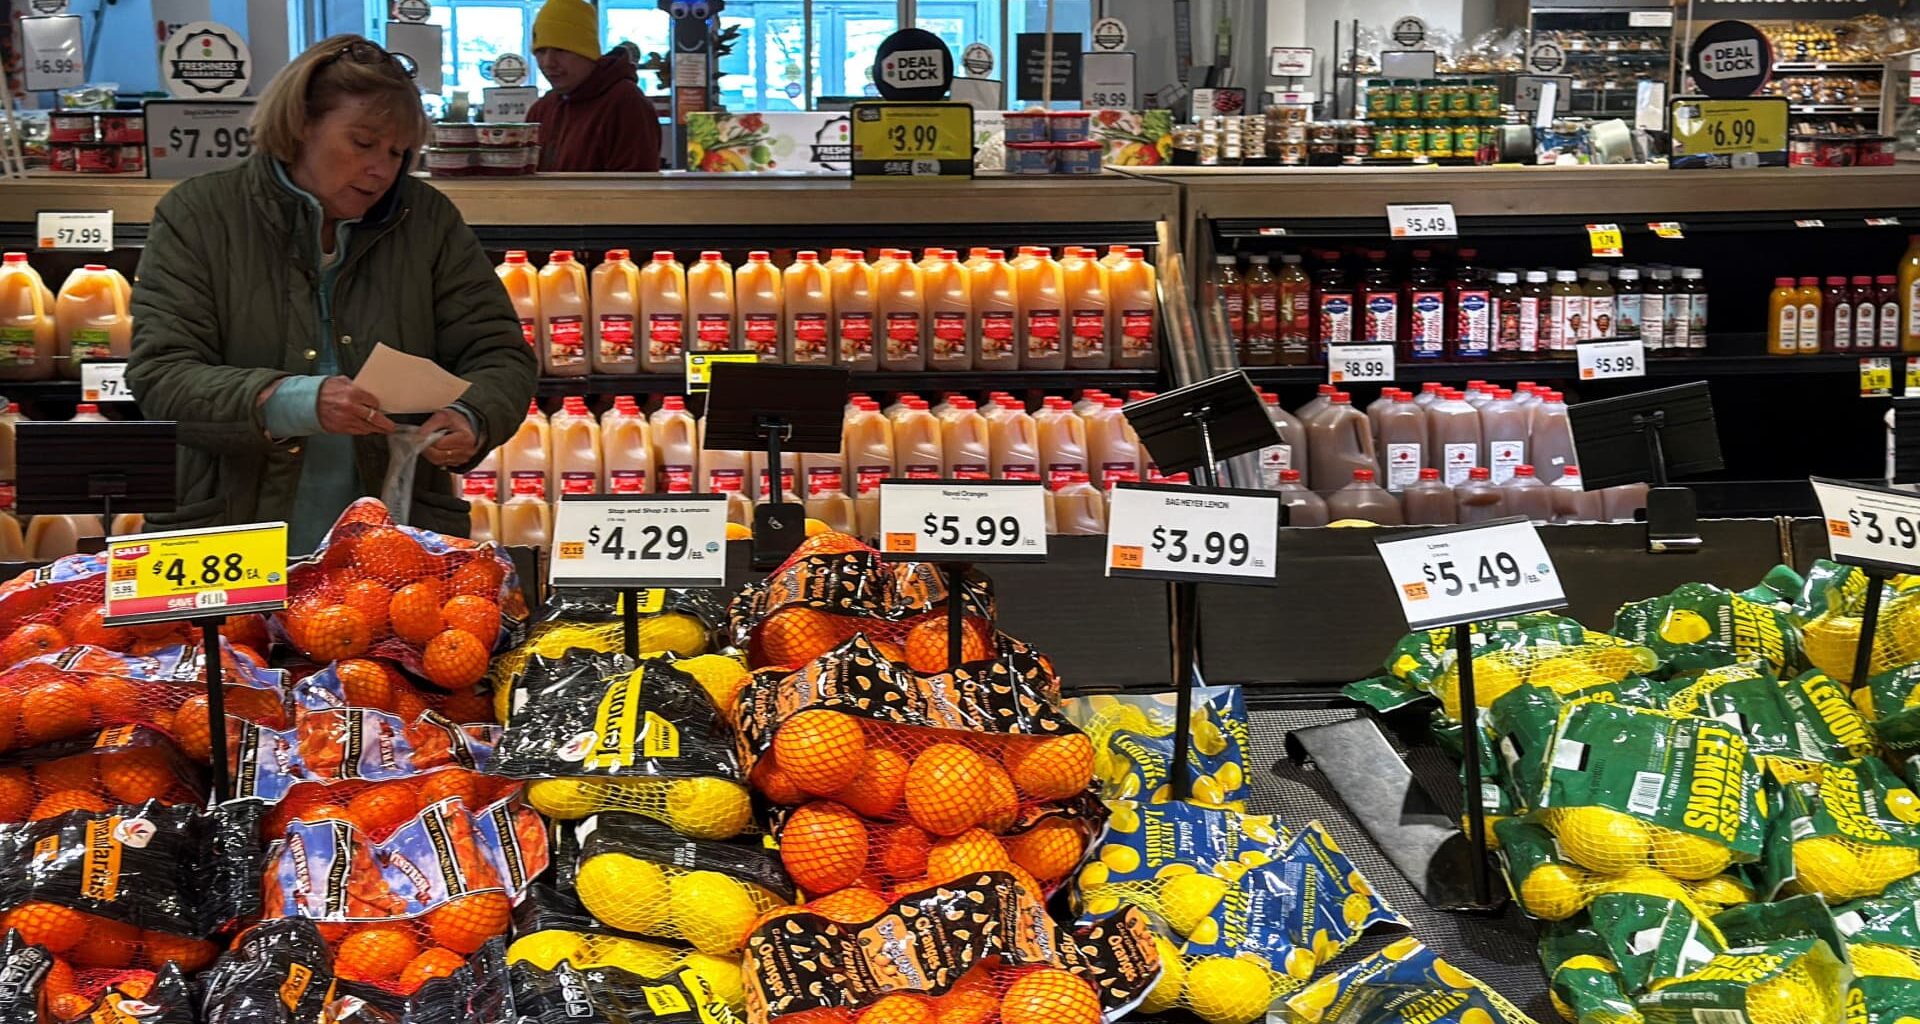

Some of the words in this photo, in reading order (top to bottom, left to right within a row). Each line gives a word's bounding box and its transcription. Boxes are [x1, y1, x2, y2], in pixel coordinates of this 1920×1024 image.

[178, 62, 237, 71] FRESHNESS
[898, 56, 933, 69] DEAL
[1715, 46, 1753, 60] DEAL
[1716, 59, 1755, 72] LOCK
[899, 68, 938, 81] LOCK
[169, 126, 251, 159] $7.99
[888, 125, 937, 152] $3.99
[1708, 119, 1755, 146] $6.99
[884, 162, 911, 173] SAVE
[1705, 157, 1729, 168] SAVE
[57, 227, 101, 244] $7.99
[1407, 217, 1445, 232] $5.49
[1345, 361, 1383, 377] $8.99
[1596, 356, 1634, 373] $5.99
[961, 490, 988, 499] Oranges
[1181, 499, 1203, 507] MEYER
[1204, 501, 1229, 509] LEMON
[588, 525, 688, 561] $4.29
[923, 512, 1020, 547] $5.99
[1848, 508, 1920, 550] $3.9
[114, 545, 149, 557] SALE
[1151, 525, 1249, 567] $3.99
[1427, 543, 1448, 551] Limes
[152, 553, 243, 587] $4.88
[1422, 552, 1521, 597] $5.49
[167, 597, 194, 608] SAVE
[1801, 675, 1873, 757] LEMONS
[351, 711, 362, 757] MANDARINS
[1113, 733, 1157, 790] Lemons
[1682, 726, 1730, 833] LEMONS
[1719, 734, 1747, 843] SEEDLESS
[1145, 810, 1165, 869] Lemons
[1162, 822, 1176, 859] MEYER
[328, 865, 342, 912] MANDARIN
[390, 850, 431, 896] VINEFRESH
[915, 917, 939, 970] Oranges
[1060, 932, 1077, 964] nges
[1107, 935, 1136, 982] Oranges
[758, 943, 787, 996] Oranges
[772, 928, 794, 971] CALIFORNIA
[787, 972, 803, 998] SWEET
[839, 939, 867, 994] Oranges
